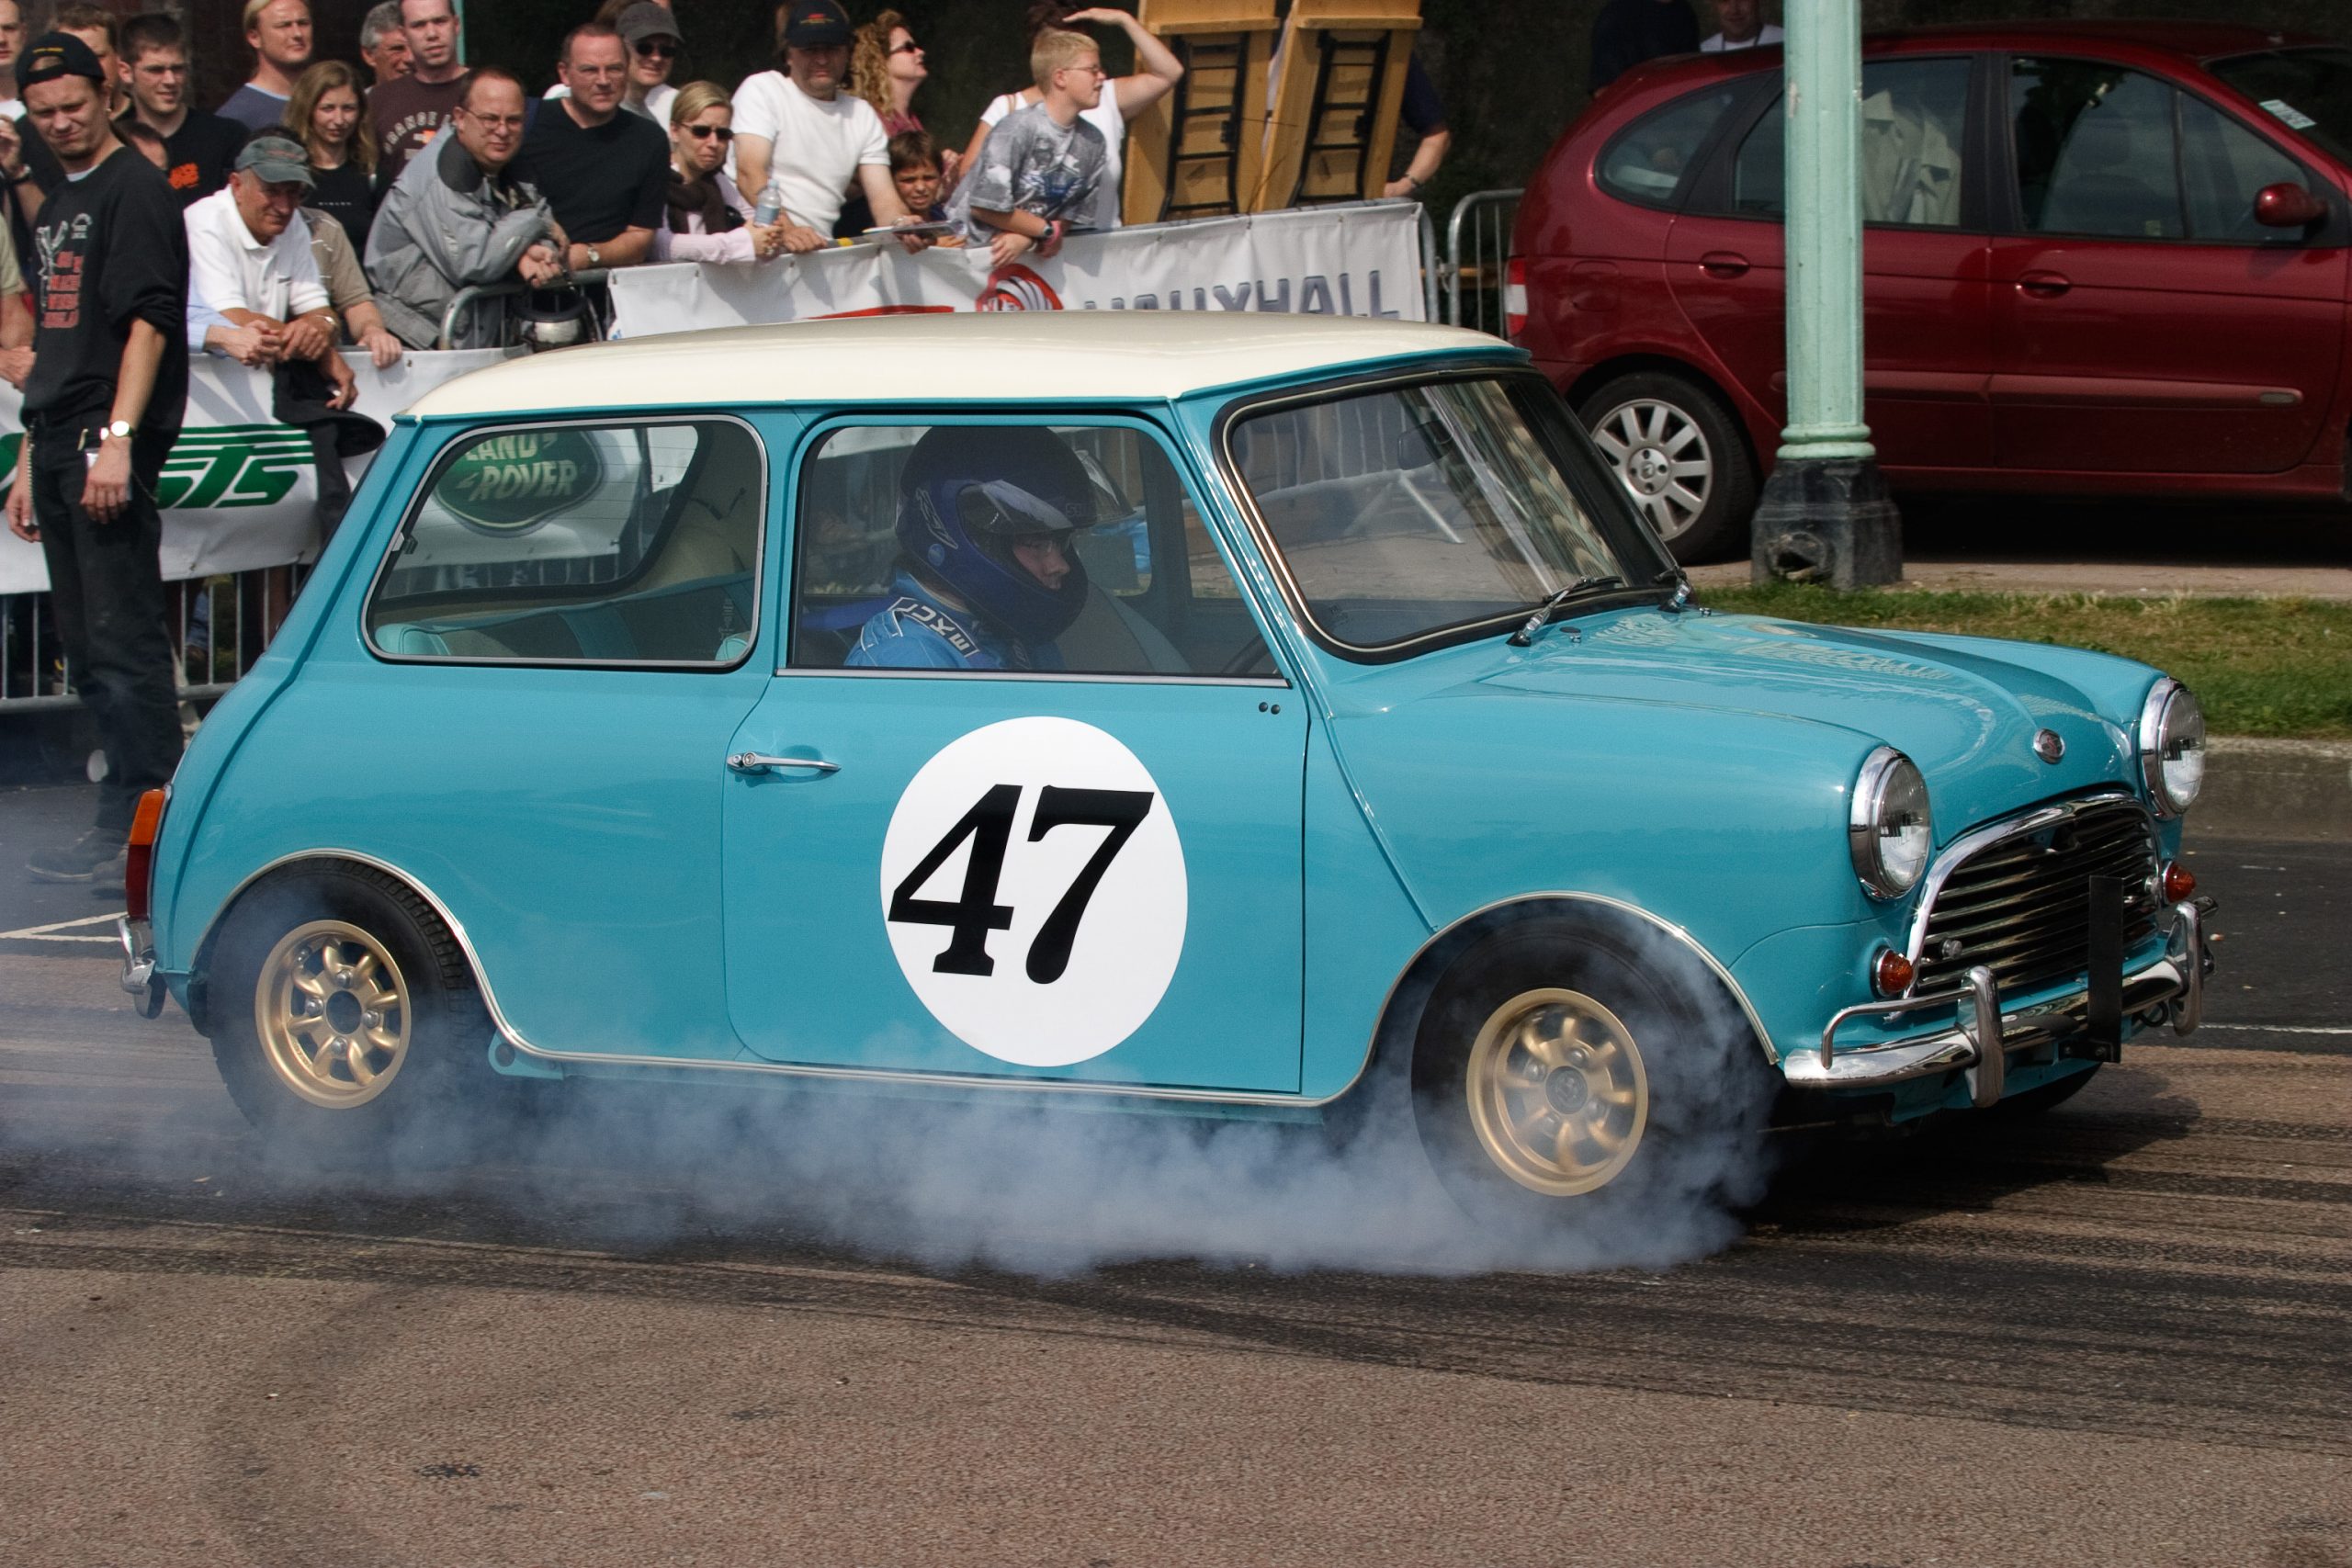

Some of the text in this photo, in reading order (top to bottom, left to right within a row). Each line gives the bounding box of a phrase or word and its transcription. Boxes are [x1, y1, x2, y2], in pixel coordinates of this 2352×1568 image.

[1085, 270, 1399, 318] XHALL
[469, 460, 576, 502] ROVER
[888, 784, 1155, 985] 47
